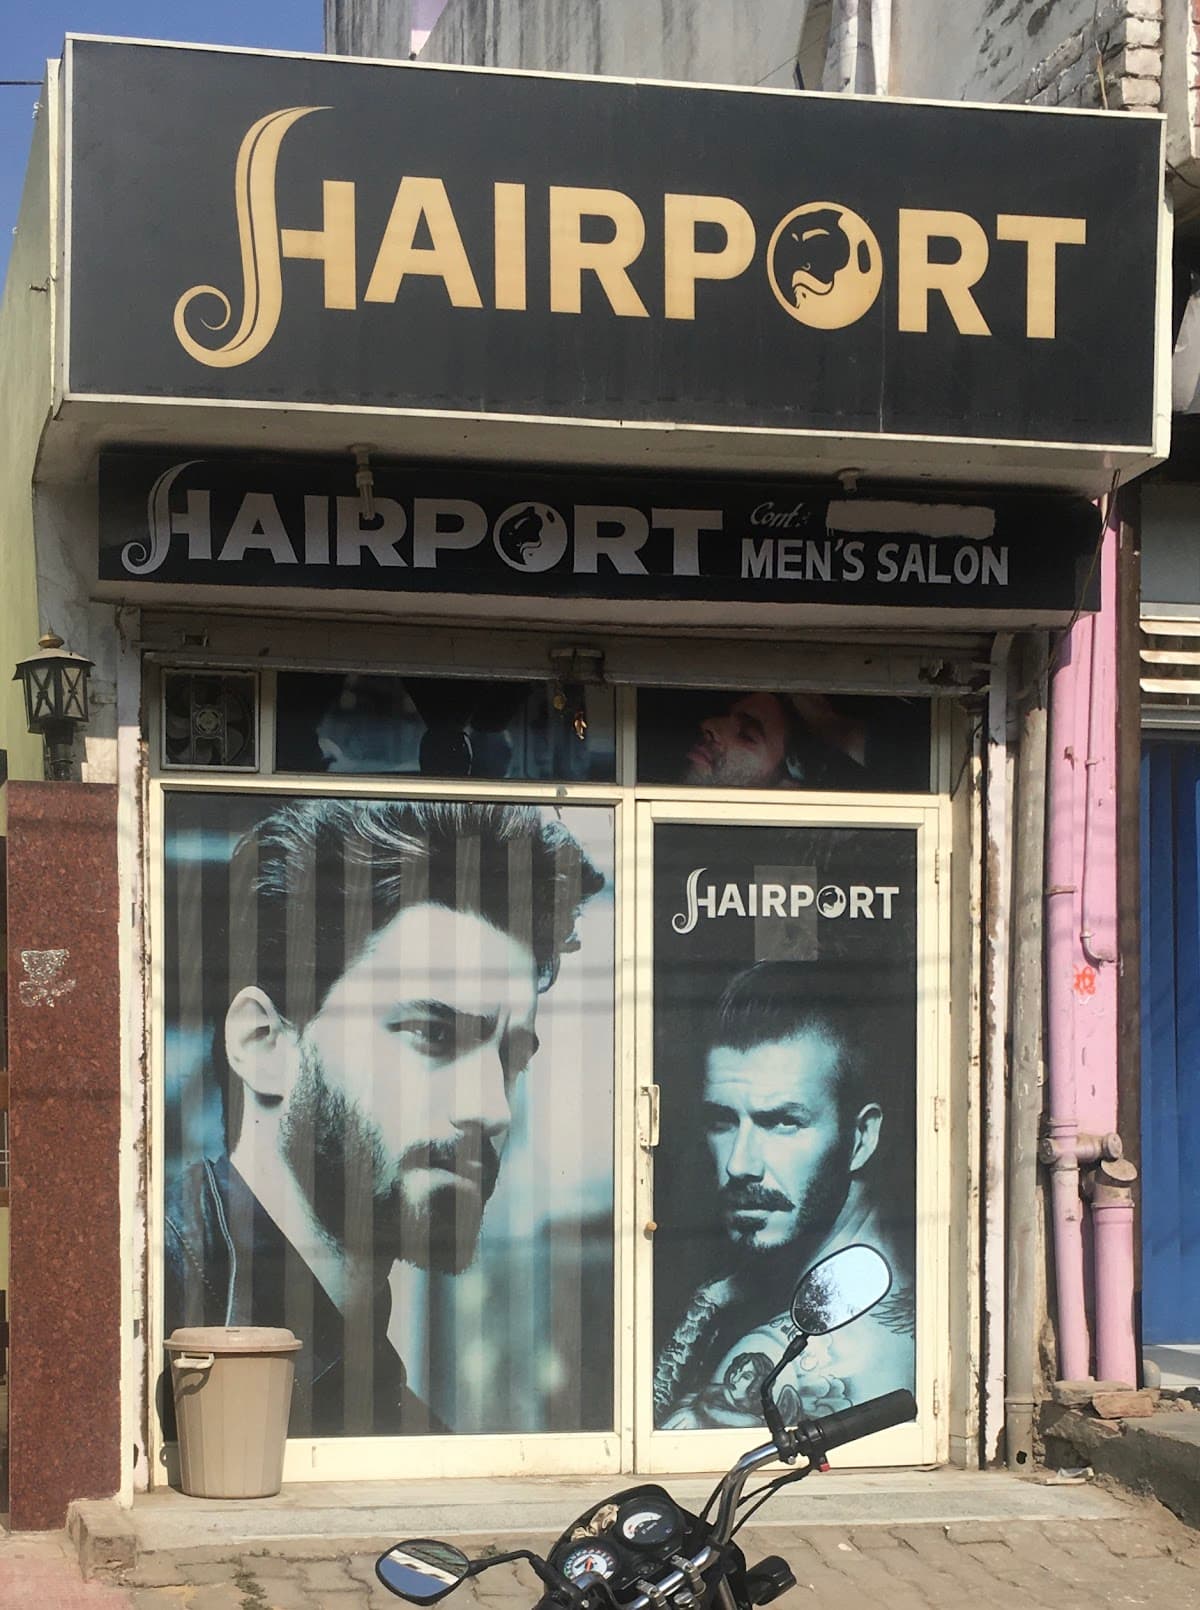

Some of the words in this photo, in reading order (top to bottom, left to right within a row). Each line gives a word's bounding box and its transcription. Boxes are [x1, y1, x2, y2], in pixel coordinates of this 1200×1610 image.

[173, 105, 1087, 368] HAIRPORT
[120, 459, 724, 577] HAIRPORT
[740, 537, 865, 582] MEN'S
[876, 541, 1009, 586] SALON
[671, 866, 900, 934] HAIRPORT
